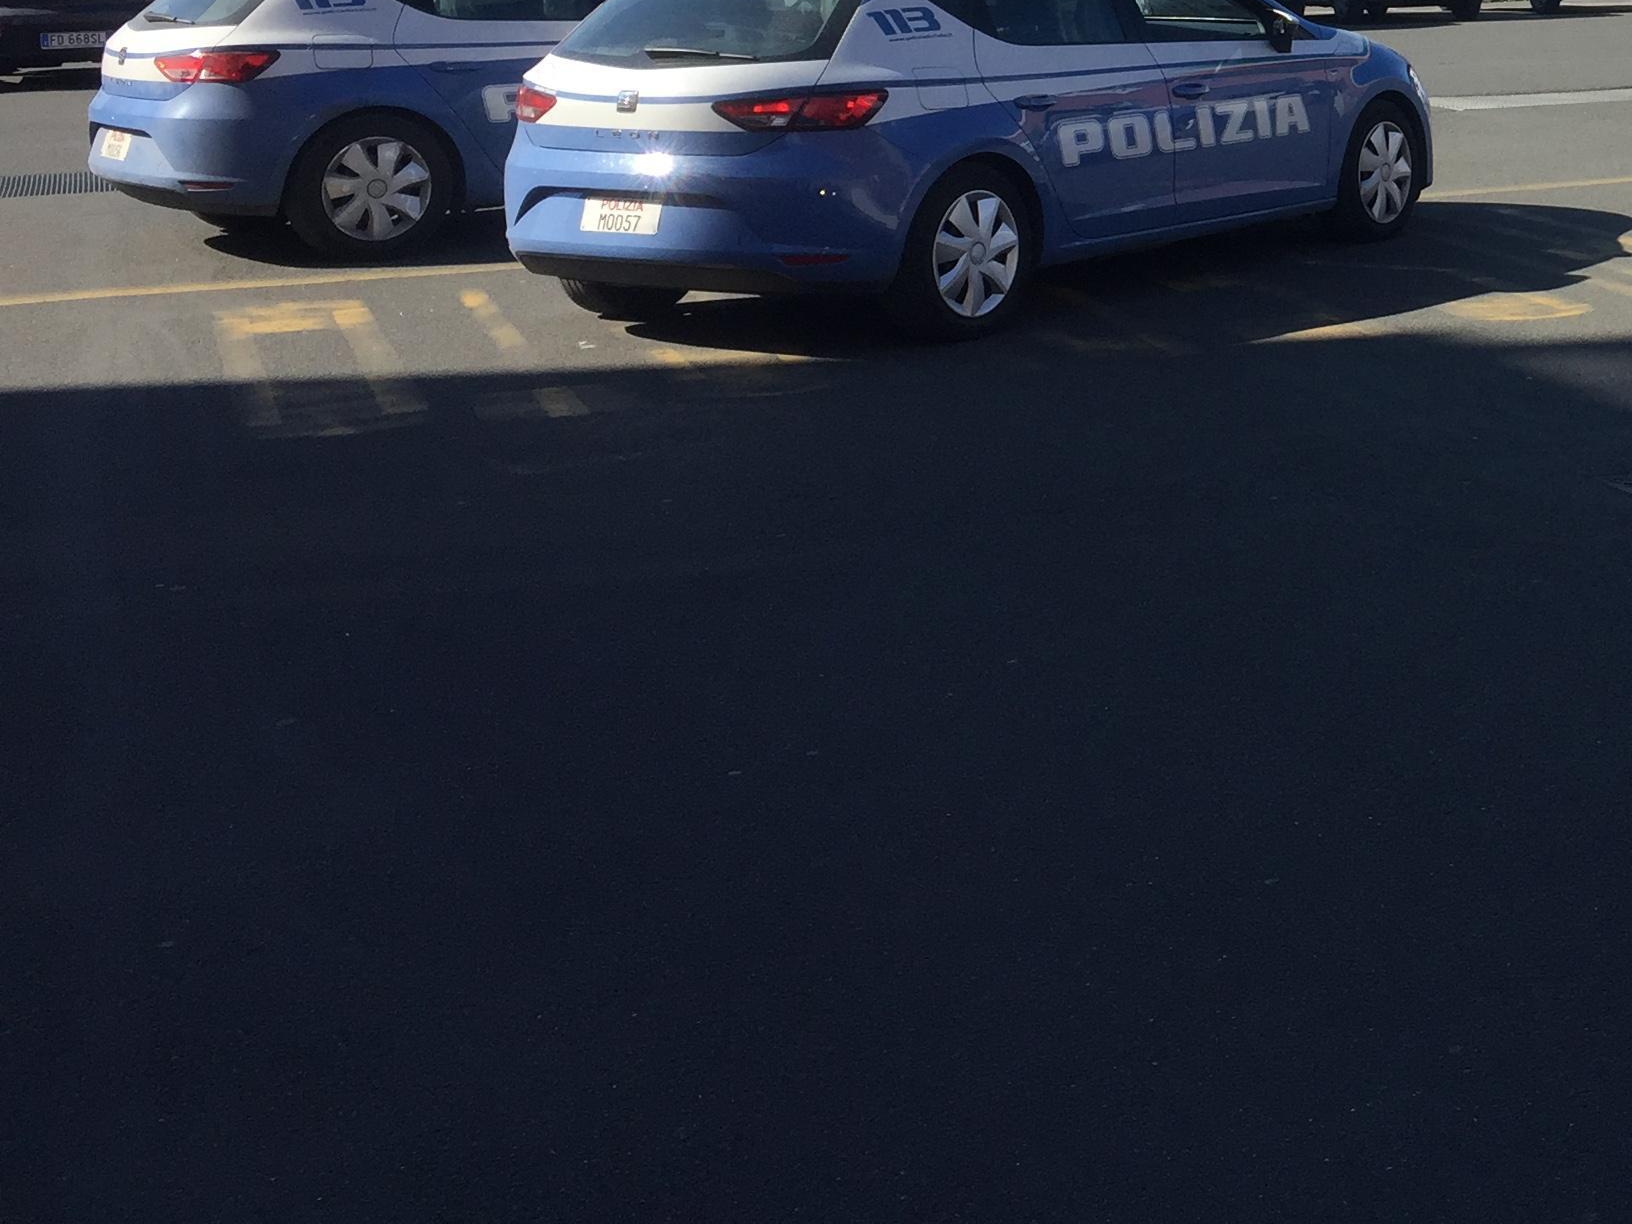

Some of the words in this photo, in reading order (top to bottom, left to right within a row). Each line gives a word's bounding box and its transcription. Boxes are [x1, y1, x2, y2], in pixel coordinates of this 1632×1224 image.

[866, 6, 941, 36] 113
[50, 34, 64, 45] FD
[1057, 93, 1311, 167] POLIZIA
[601, 199, 643, 211] POLIZIA
[598, 214, 641, 232] M0057
